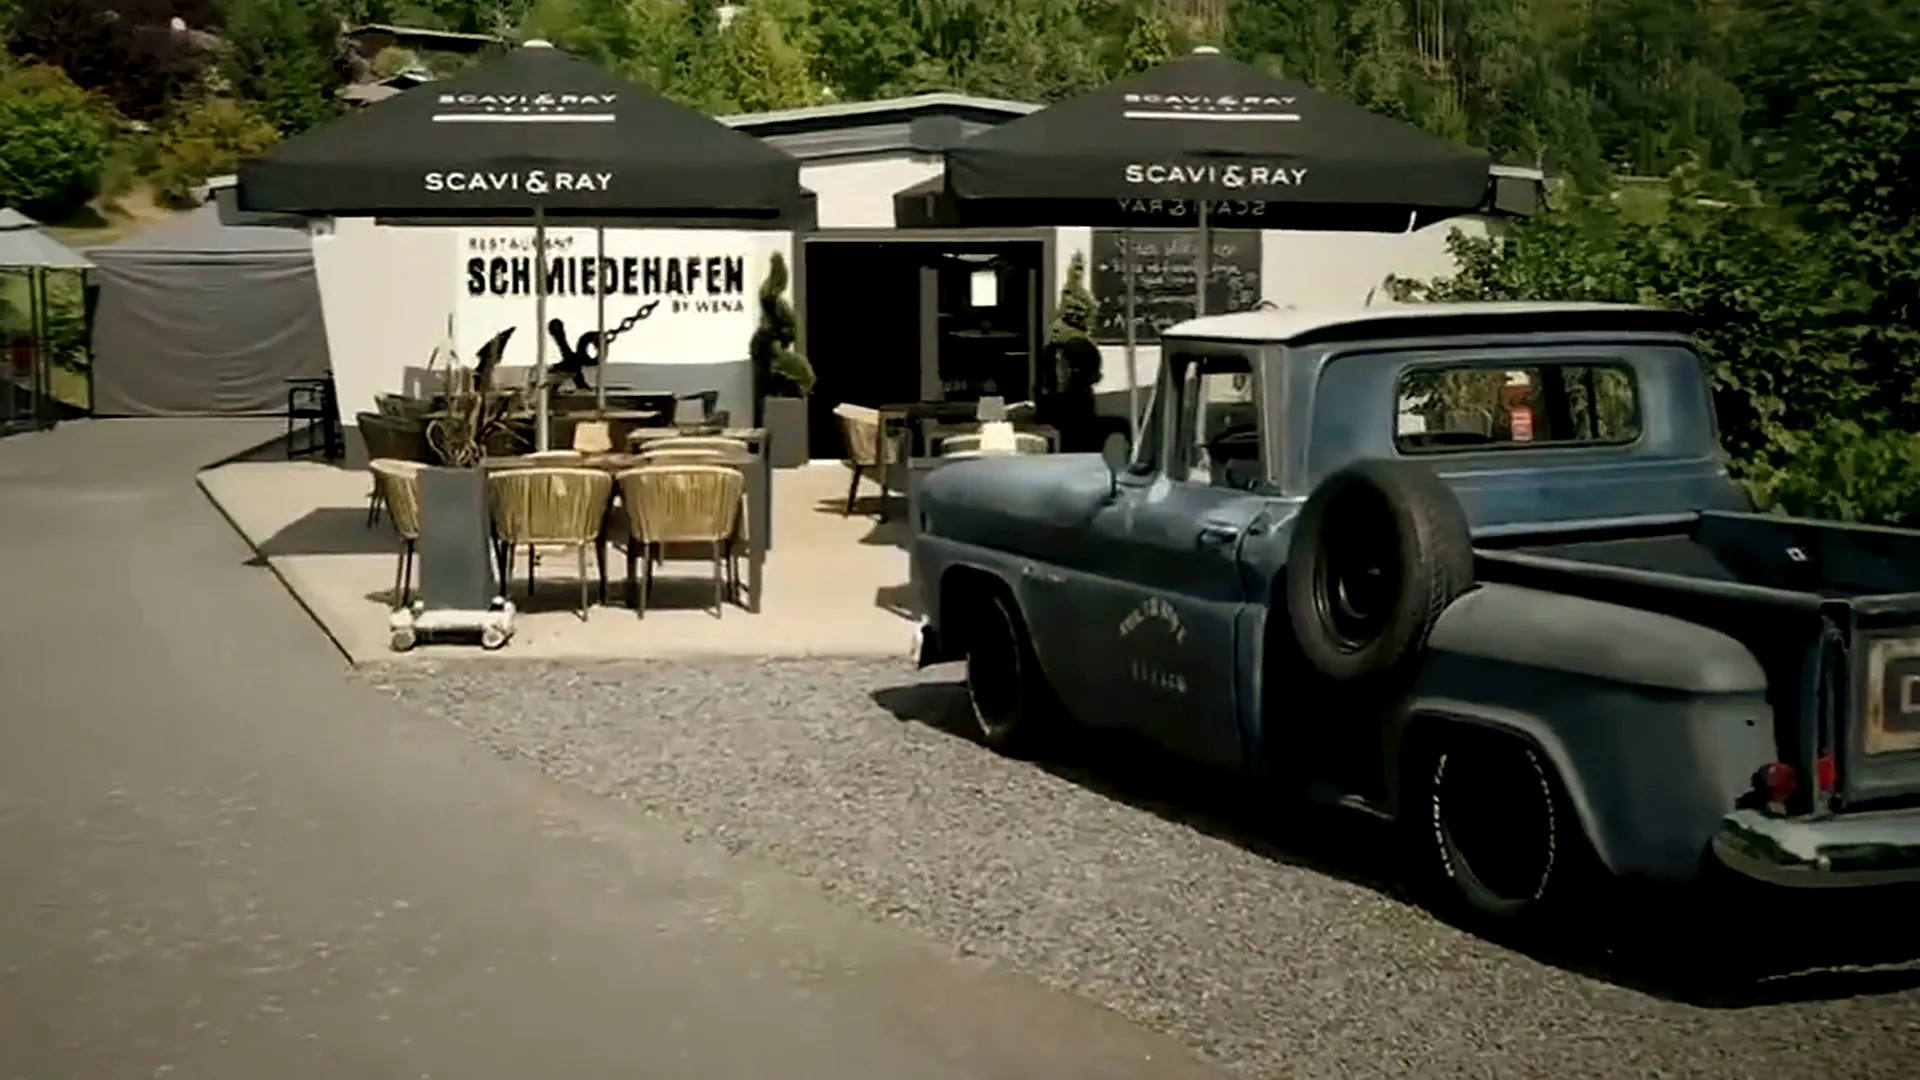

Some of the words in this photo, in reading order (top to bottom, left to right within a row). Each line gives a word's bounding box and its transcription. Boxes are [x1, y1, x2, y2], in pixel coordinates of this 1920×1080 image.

[561, 94, 616, 104] RAY
[424, 172, 518, 191] SCAVI
[525, 170, 549, 193] &
[555, 173, 612, 190] RAY
[1125, 164, 1215, 183] SCAVI
[1222, 165, 1245, 187] &
[1250, 167, 1308, 186] RAY
[467, 256, 744, 296] SCHMIEDEHAFEN
[672, 300, 689, 314] BY
